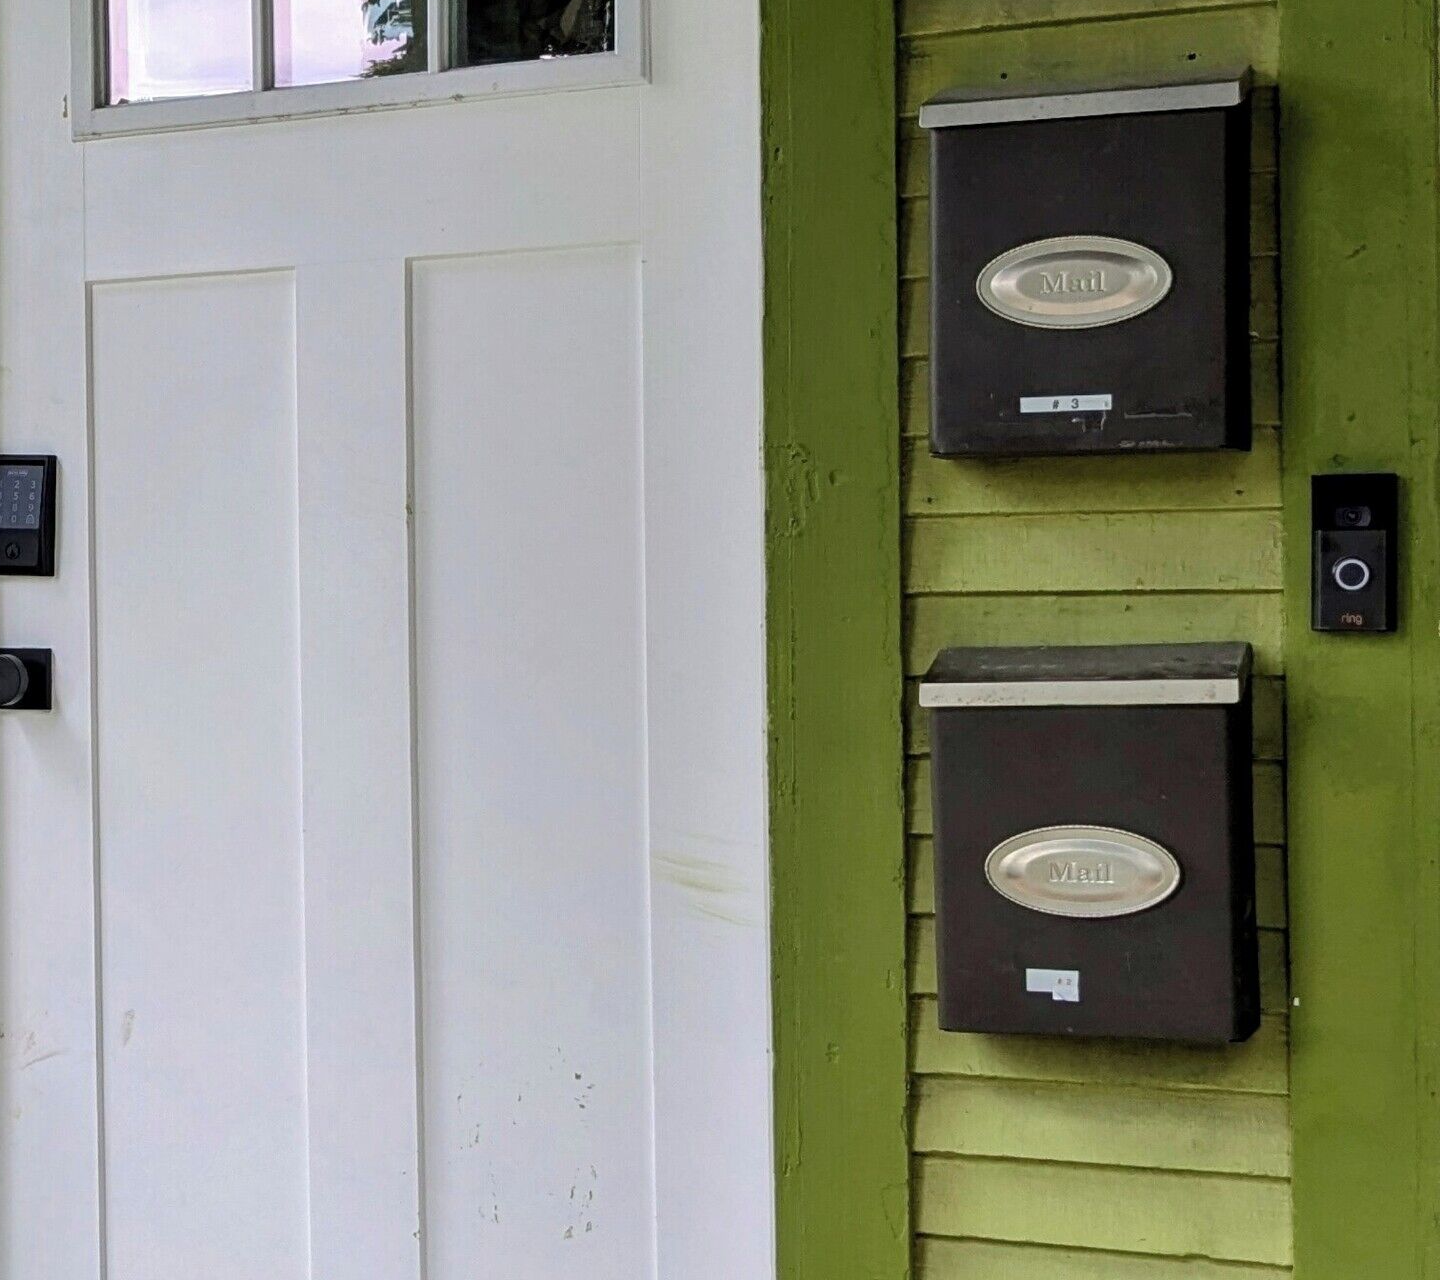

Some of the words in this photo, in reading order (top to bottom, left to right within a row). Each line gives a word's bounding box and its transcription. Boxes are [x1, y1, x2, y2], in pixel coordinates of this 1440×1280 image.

[1039, 270, 1106, 295] Mail
[1071, 398, 1080, 410] 3
[14, 480, 20, 489] 2
[31, 480, 36, 489] 3
[13, 492, 19, 501] 5
[29, 492, 35, 501] 6
[1341, 613, 1363, 626] ring
[1048, 861, 1114, 884] Mail
